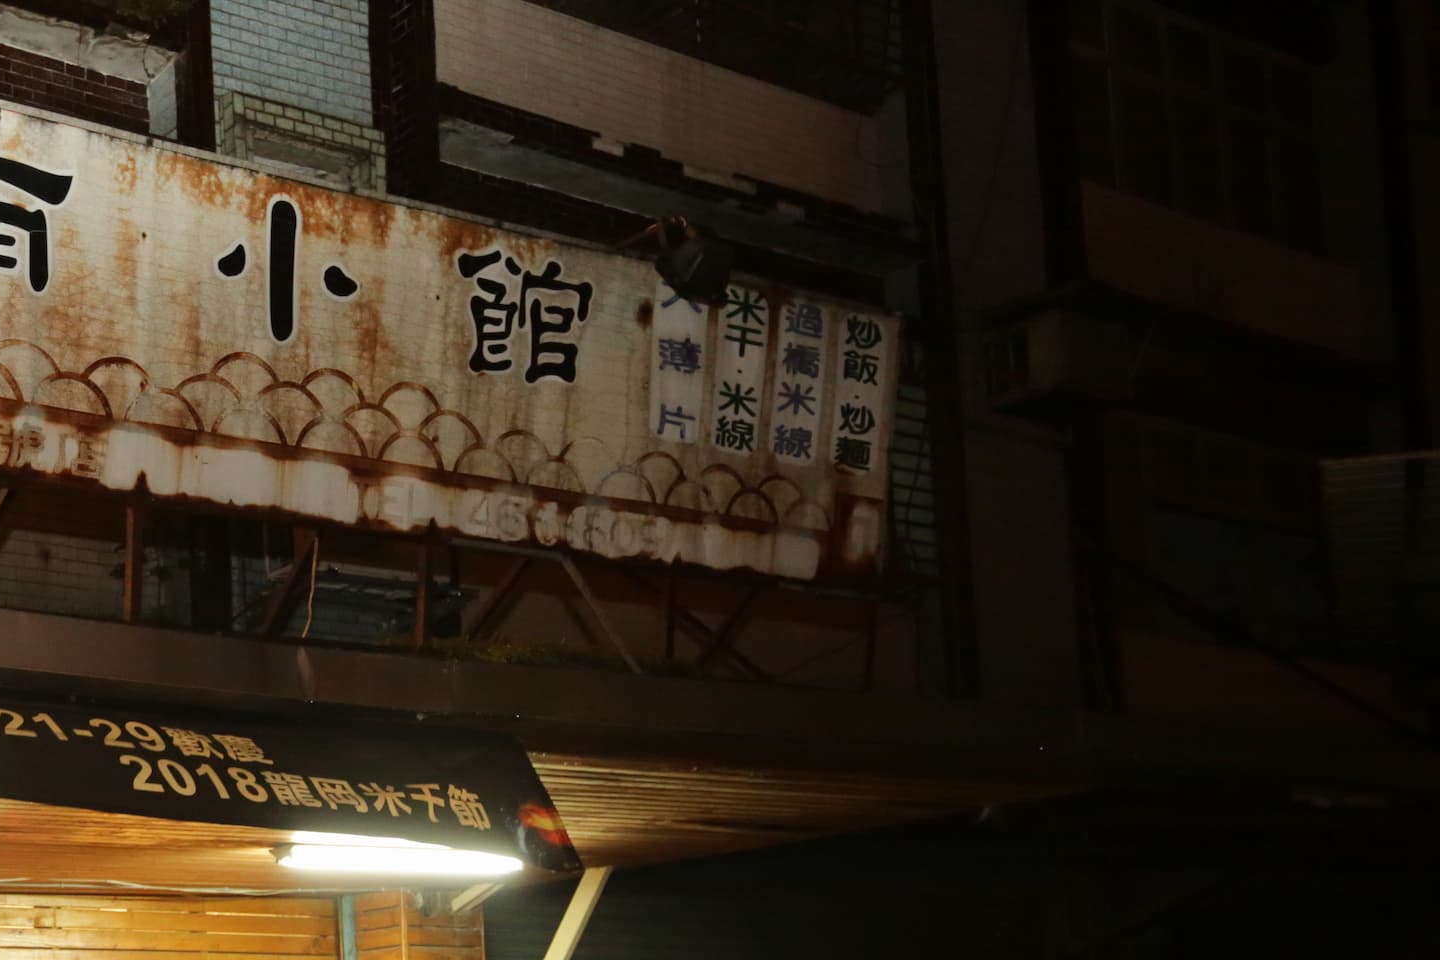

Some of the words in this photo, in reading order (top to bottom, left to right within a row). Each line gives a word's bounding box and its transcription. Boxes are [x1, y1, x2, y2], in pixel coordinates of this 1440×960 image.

[772, 301, 824, 460] 過橋米線
[119, 753, 492, 832] 2018龍岡米干節
